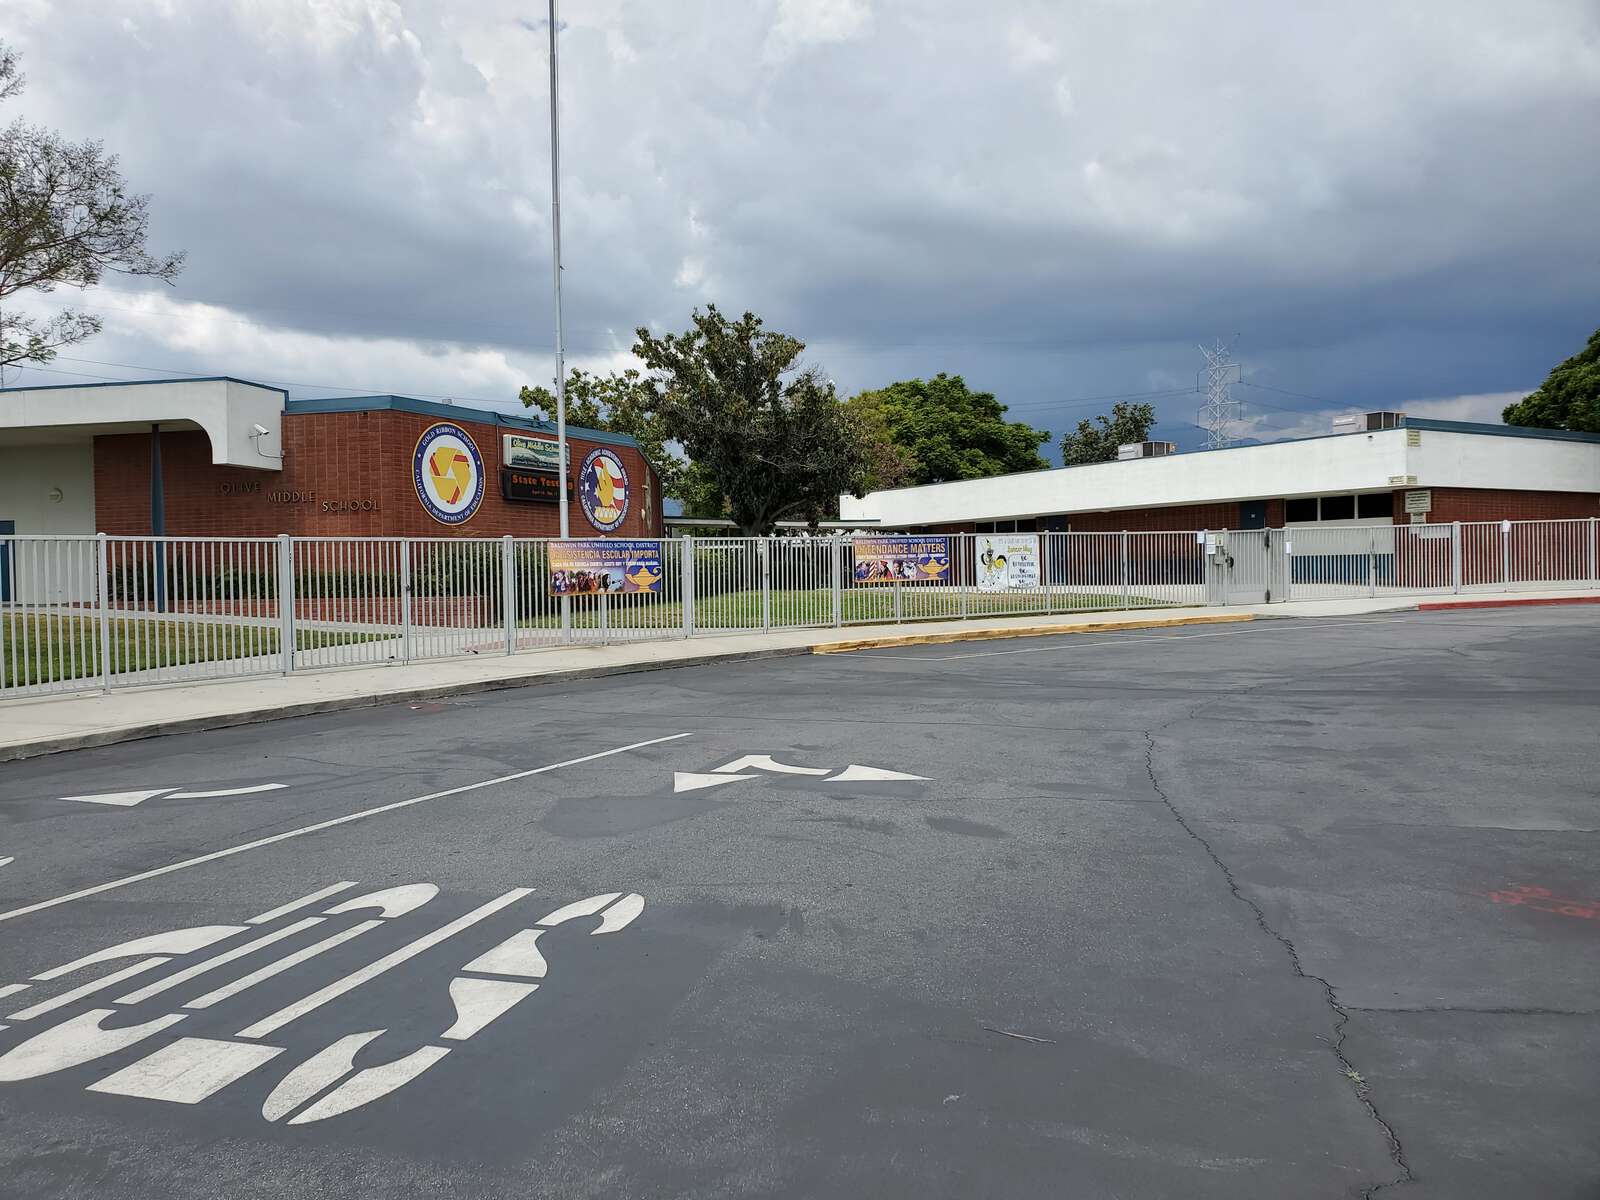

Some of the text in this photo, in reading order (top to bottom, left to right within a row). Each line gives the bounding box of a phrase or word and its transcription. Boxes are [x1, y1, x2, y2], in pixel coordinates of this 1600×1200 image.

[422, 425, 475, 452] GOLD RIBBON SCHOOL
[512, 439, 526, 448] Olive
[512, 474, 574, 490] State Testg
[222, 483, 380, 513] OLIVE MIDDLE SCHOOL
[414, 469, 432, 510] CALIFORNIA
[431, 507, 464, 522] DEPARTMENT
[470, 476, 484, 511] EDUCATION
[602, 550, 630, 559] ESCOLAR
[856, 543, 946, 554] ATTENDANCE MATTERS
